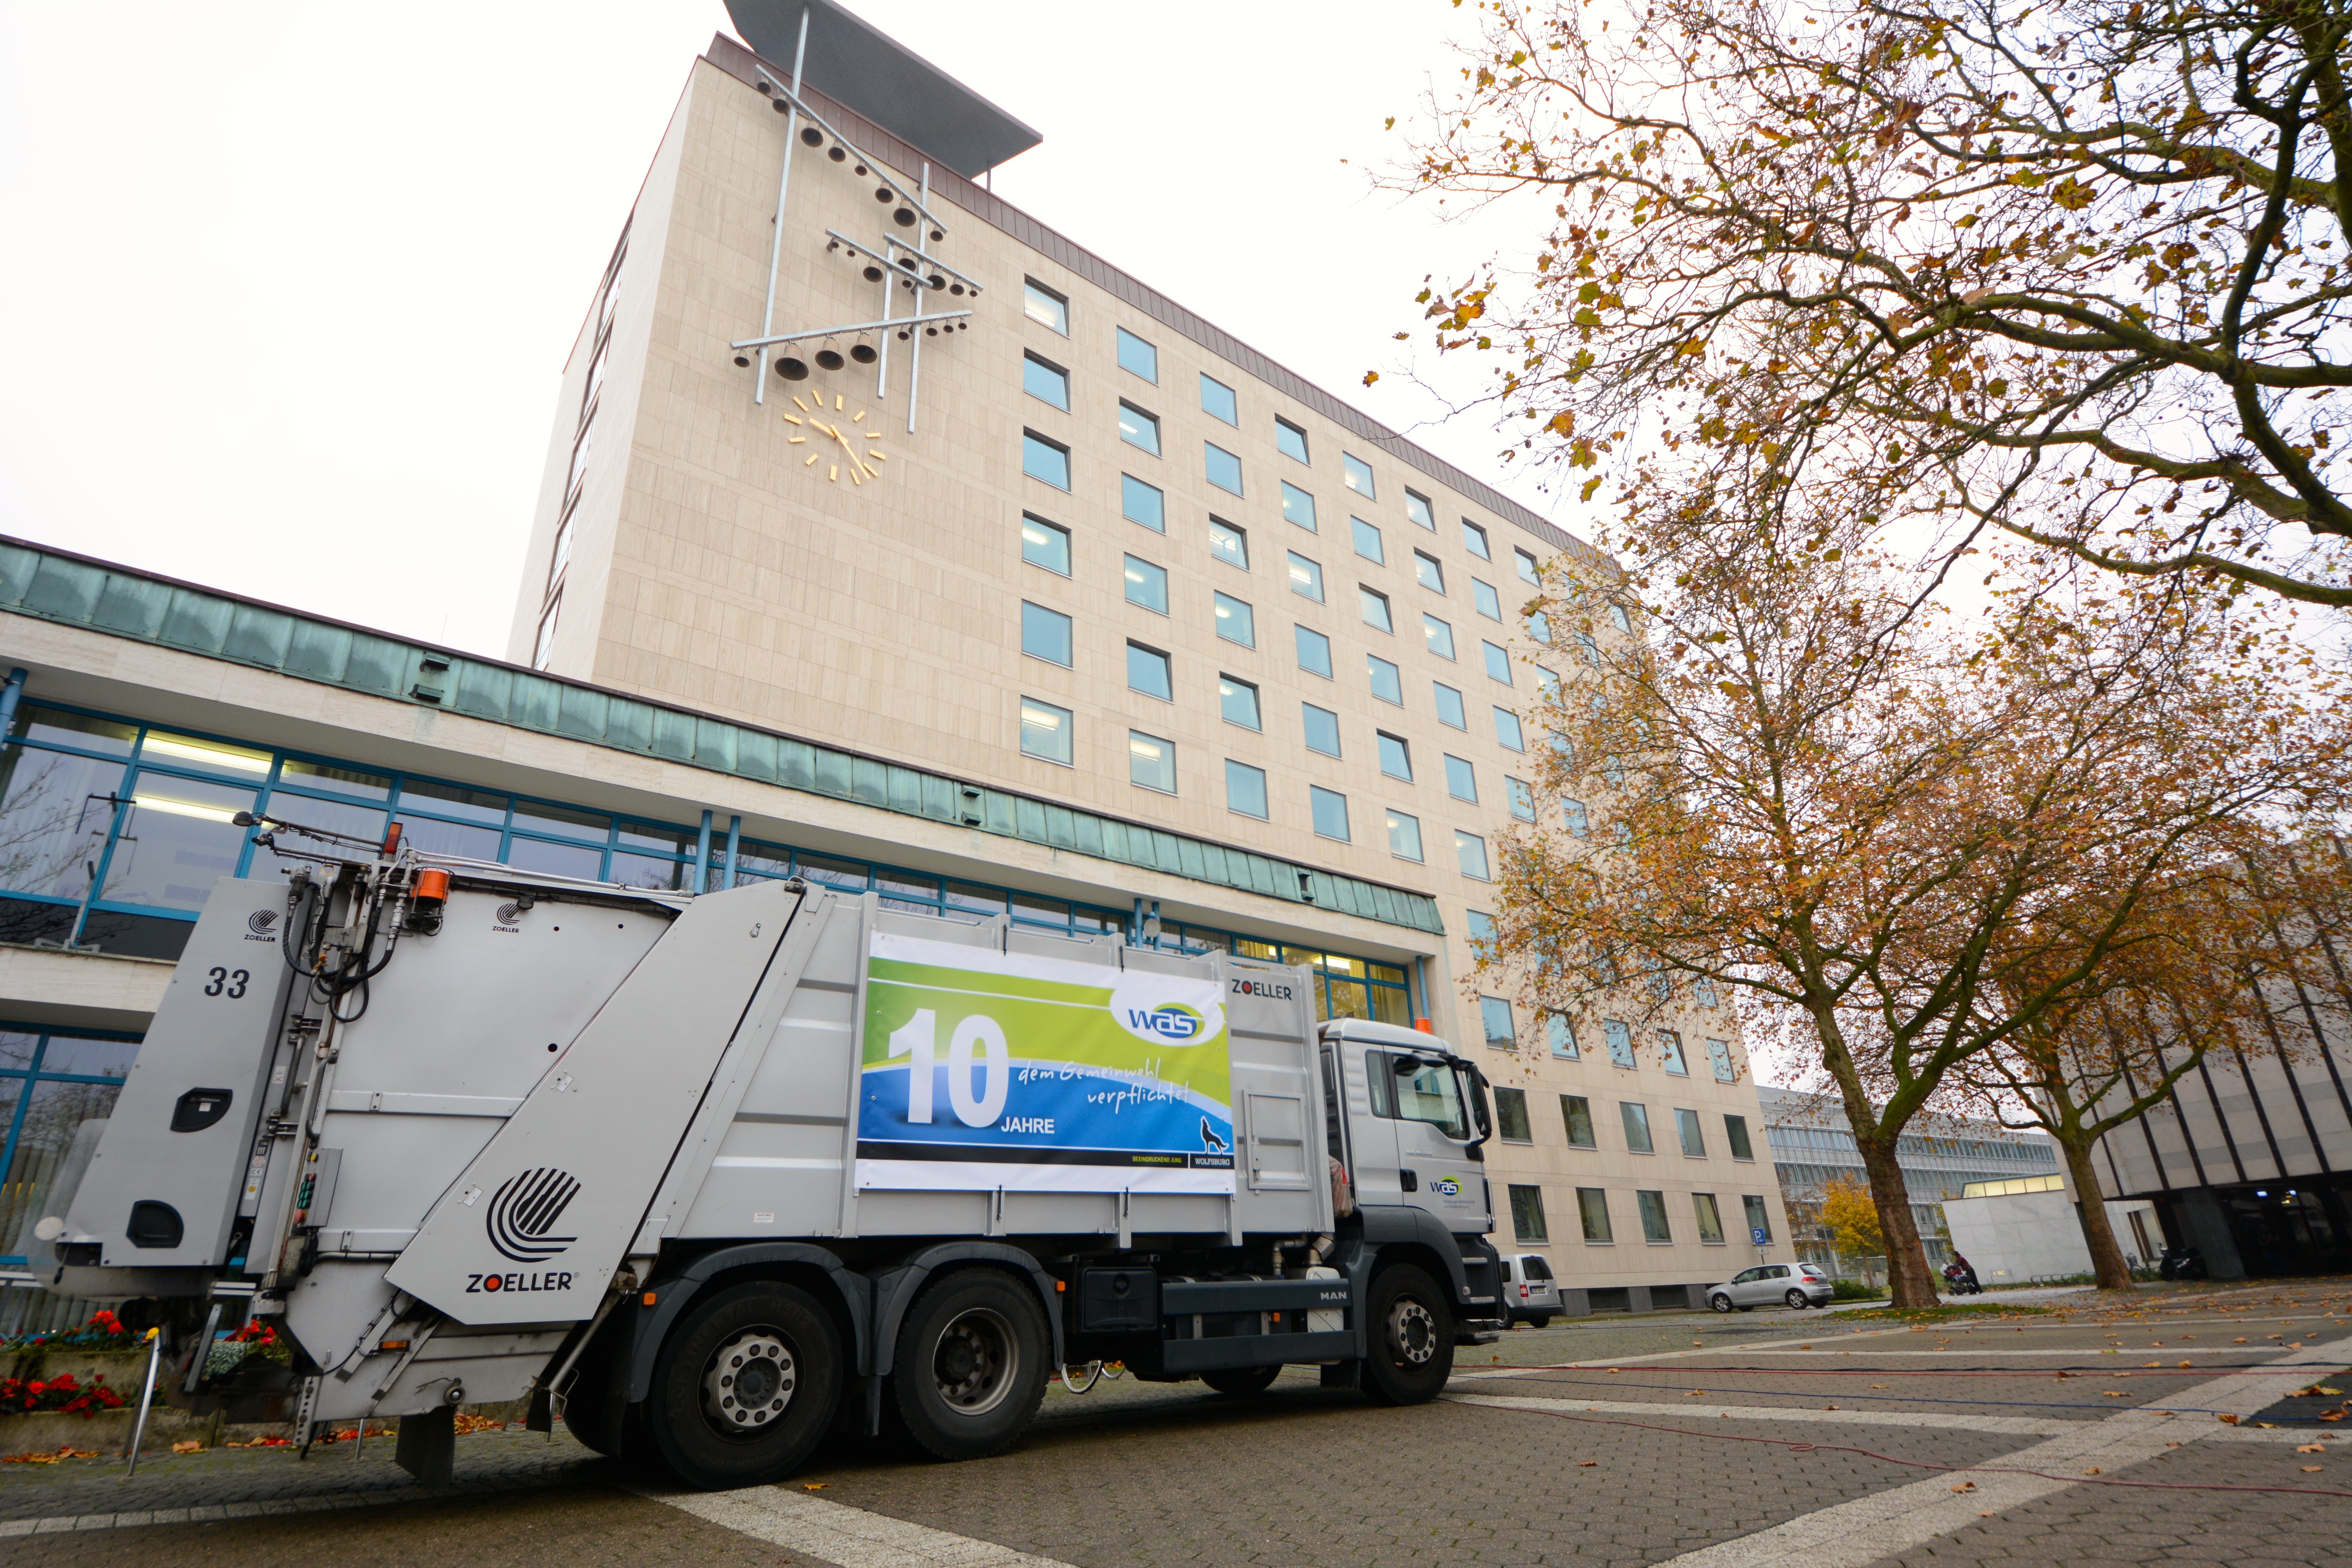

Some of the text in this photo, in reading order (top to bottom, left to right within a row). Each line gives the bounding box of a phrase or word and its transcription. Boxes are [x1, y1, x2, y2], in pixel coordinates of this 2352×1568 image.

[244, 934, 276, 942] ZOELLER
[205, 967, 249, 999] 33
[1232, 978, 1292, 1001] ZOELLER
[889, 1008, 1008, 1127] 10
[1018, 1058, 1160, 1085] dem Gemeinwohl
[1088, 1081, 1189, 1114] verpflichtet
[1001, 1117, 1054, 1134] JAHRE
[1754, 1230, 1761, 1243] P
[1320, 1292, 1347, 1300] MAN
[770, 1298, 813, 1329] HSR2
